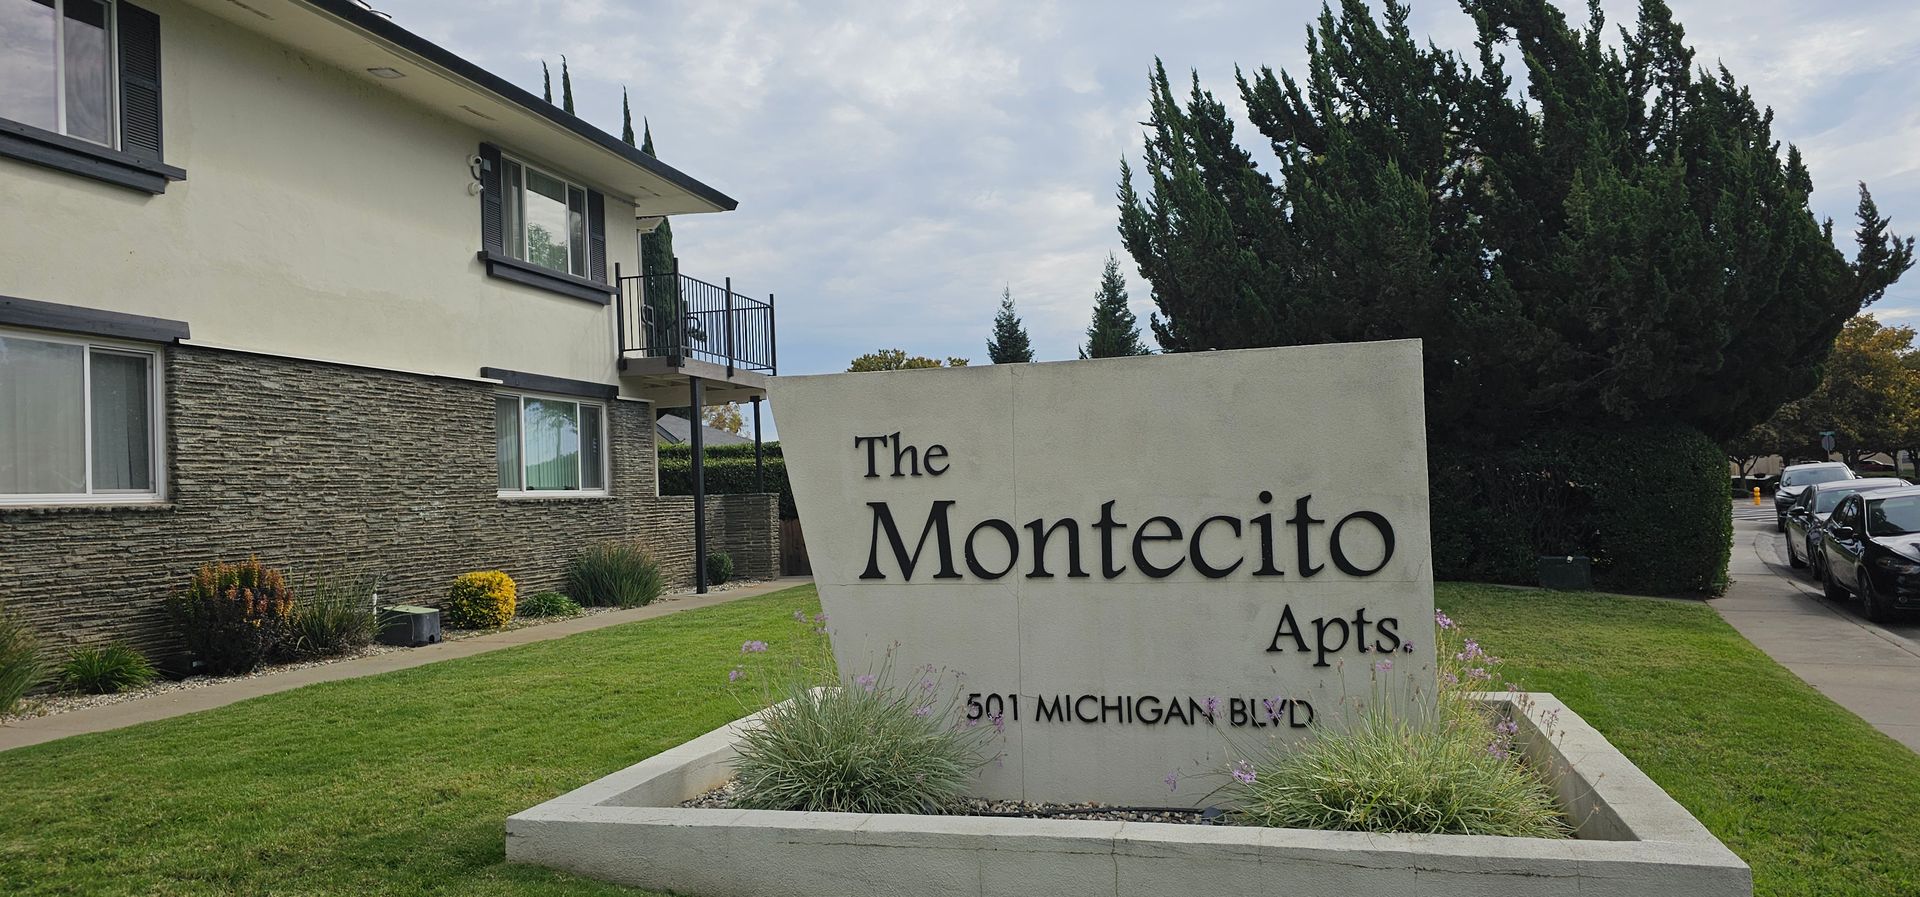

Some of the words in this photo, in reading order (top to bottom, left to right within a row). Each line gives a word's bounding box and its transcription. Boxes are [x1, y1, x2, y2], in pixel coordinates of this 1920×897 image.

[854, 431, 950, 480] The
[858, 490, 1396, 582] Montecito
[1265, 603, 1414, 669] Apts.
[966, 692, 1020, 723] 501
[1035, 694, 1216, 727] MICHIGAN
